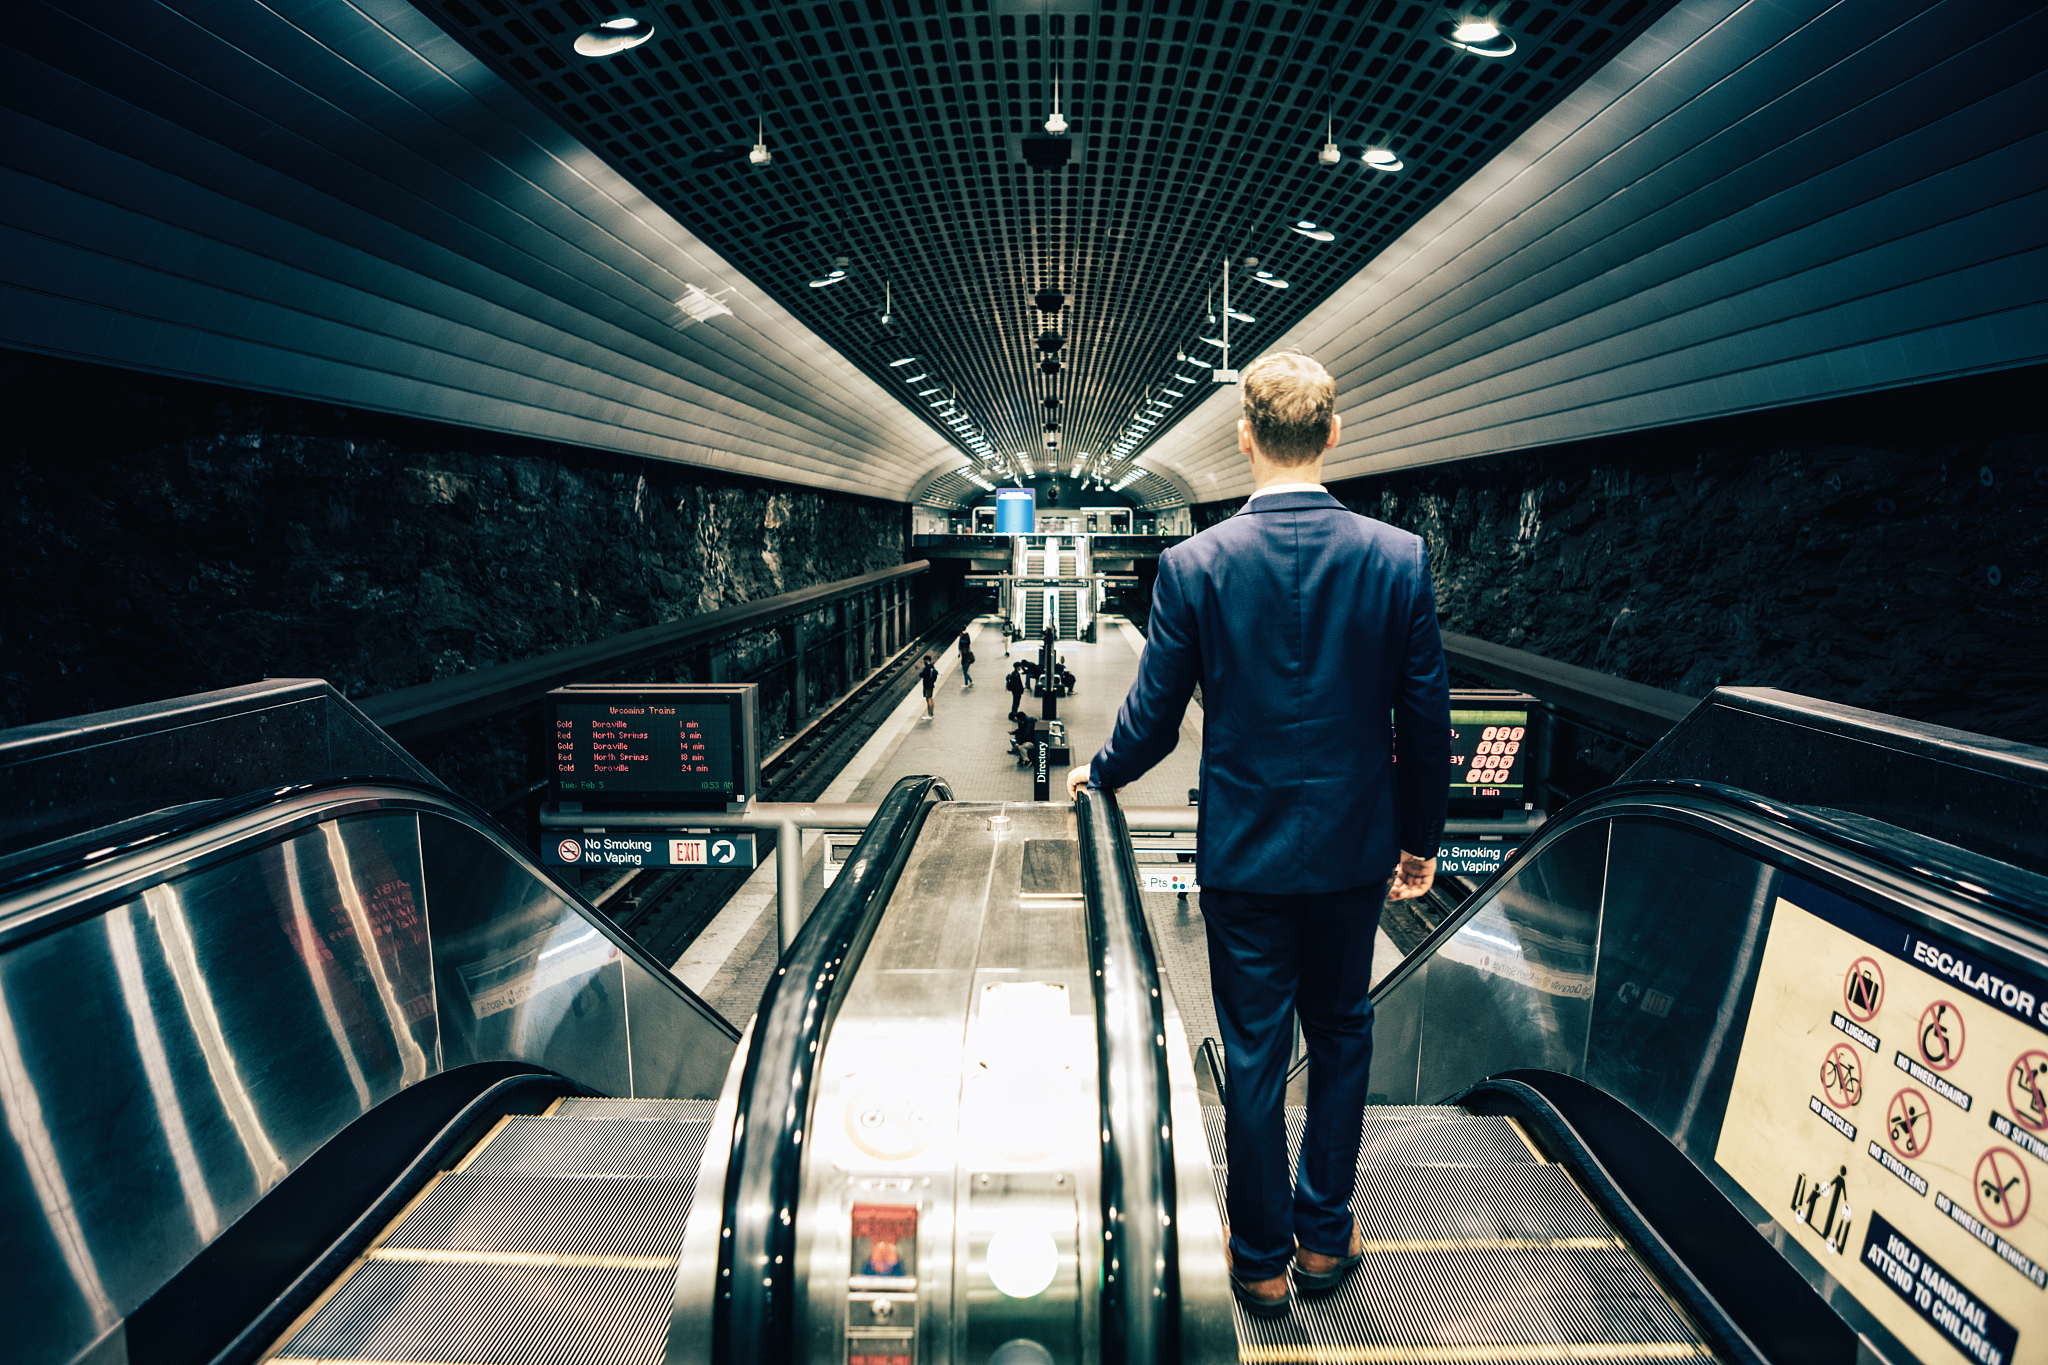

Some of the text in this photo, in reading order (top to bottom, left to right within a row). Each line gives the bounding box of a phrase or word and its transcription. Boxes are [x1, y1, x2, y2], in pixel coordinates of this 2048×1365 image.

[609, 706, 676, 715] Upcoming Trains
[556, 720, 573, 728] Gold
[592, 720, 627, 728] Doraville
[686, 720, 699, 728] min
[557, 731, 702, 740] Red North Springs 8 min
[557, 742, 705, 750] Gold Doraville 14 min
[558, 753, 705, 762] Red North Springs 18 min
[1036, 741, 1049, 783] Directory
[558, 764, 709, 772] Gold Doraville 24 min
[581, 781, 596, 789] Feb
[599, 781, 604, 789] 5
[701, 781, 734, 789] 10:53 AM
[1472, 785, 1500, 796] 1 min
[584, 839, 652, 852] No Smoking
[585, 852, 642, 865] No Vaping
[676, 843, 701, 862] EXIT
[1451, 846, 1501, 860] Smoking
[1442, 860, 1500, 873] No Vaping
[1150, 877, 1168, 888] Pts
[1913, 940, 2036, 1018] ESCALATOR
[1833, 1014, 1878, 1052] NO LUGGAGE
[1896, 1054, 1970, 1110] NO WHEELCHAIRS
[1811, 1097, 1854, 1138] NO BICYCLES
[1994, 1116, 2011, 1135] NO
[1869, 1142, 1927, 1195] NO STROLLERS
[1936, 1192, 2046, 1287] NO WHEELED VEHICLES
[1886, 1233, 1988, 1335] HOLD HANDRAIL
[1867, 1243, 2003, 1365] ATTEND TO CHILDREN
